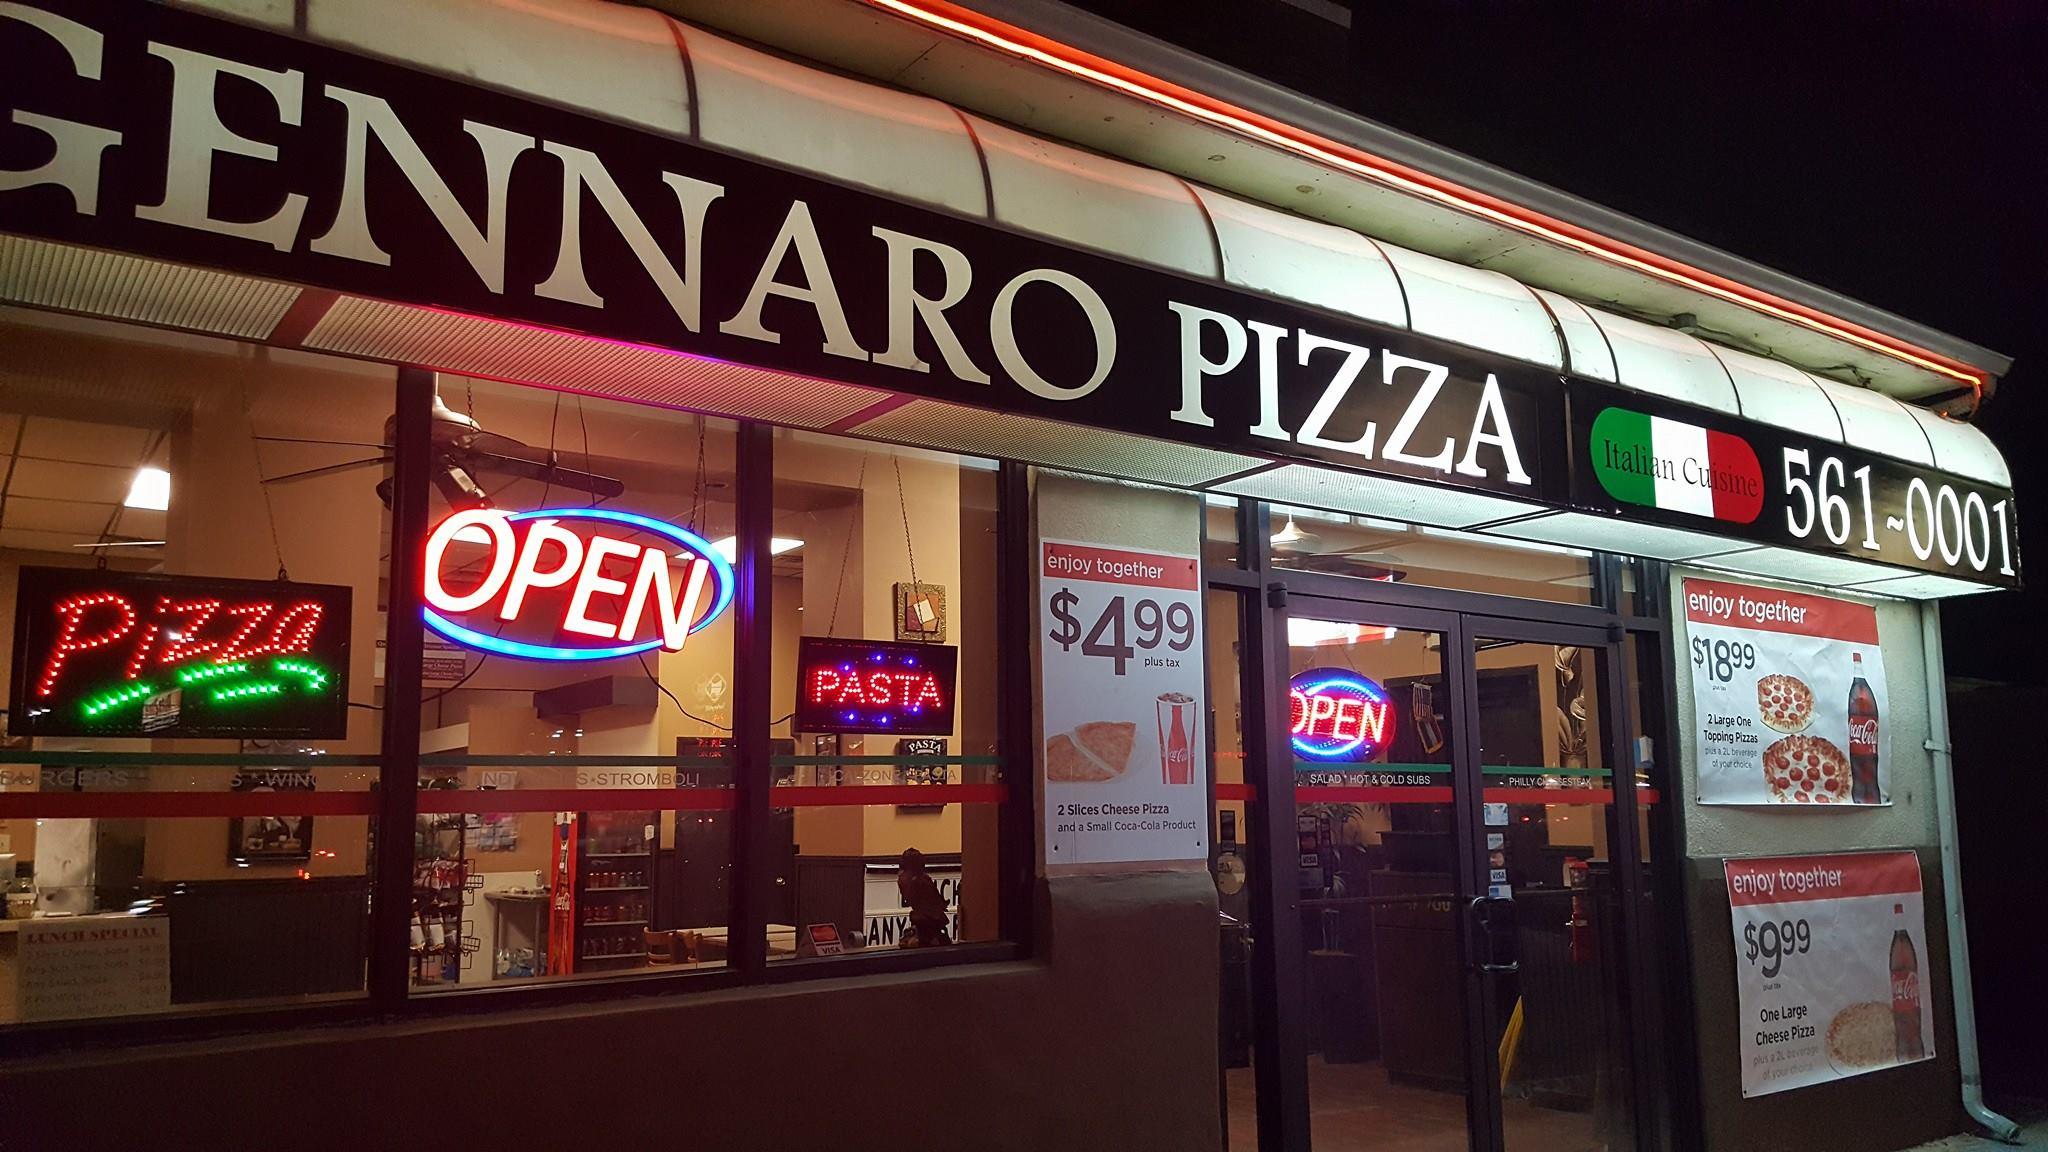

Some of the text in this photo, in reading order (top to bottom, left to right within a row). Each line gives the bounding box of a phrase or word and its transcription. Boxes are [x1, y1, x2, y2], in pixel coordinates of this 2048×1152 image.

[0, 1, 1532, 485] GENNARO PIZZA
[1604, 438, 1760, 498] Italian Cuisine
[1047, 553, 1163, 579] enjoy together
[424, 508, 710, 651] OPEN
[1689, 590, 1806, 624] enjoy together
[1144, 657, 1180, 668] plus tax
[816, 670, 942, 707] PASTA
[1707, 713, 1752, 727] 2 Large One
[1703, 730, 1758, 744] Topping Pizzas
[908, 739, 942, 753] PASTA
[1705, 747, 1716, 756] plus
[1723, 747, 1730, 756] 2L
[1731, 748, 1758, 758] beverage
[1712, 759, 1752, 769] of your choice
[597, 773, 700, 786] STROMBOLI
[1310, 774, 1431, 785] SALAD HOT & COLD SUBS
[1509, 777, 1592, 786] PHILLY CHSESTEAK
[1058, 803, 1169, 816] 2 Slices Cheese Pizza
[1058, 819, 1196, 832] and a Small Coca-Cola Product
[1733, 865, 1843, 897] enjoy together
[821, 946, 841, 955] VISA
[1760, 1004, 1808, 1023] One Large
[1756, 1024, 1815, 1046] Cheese Pizza
[1753, 1054, 1768, 1067] plus
